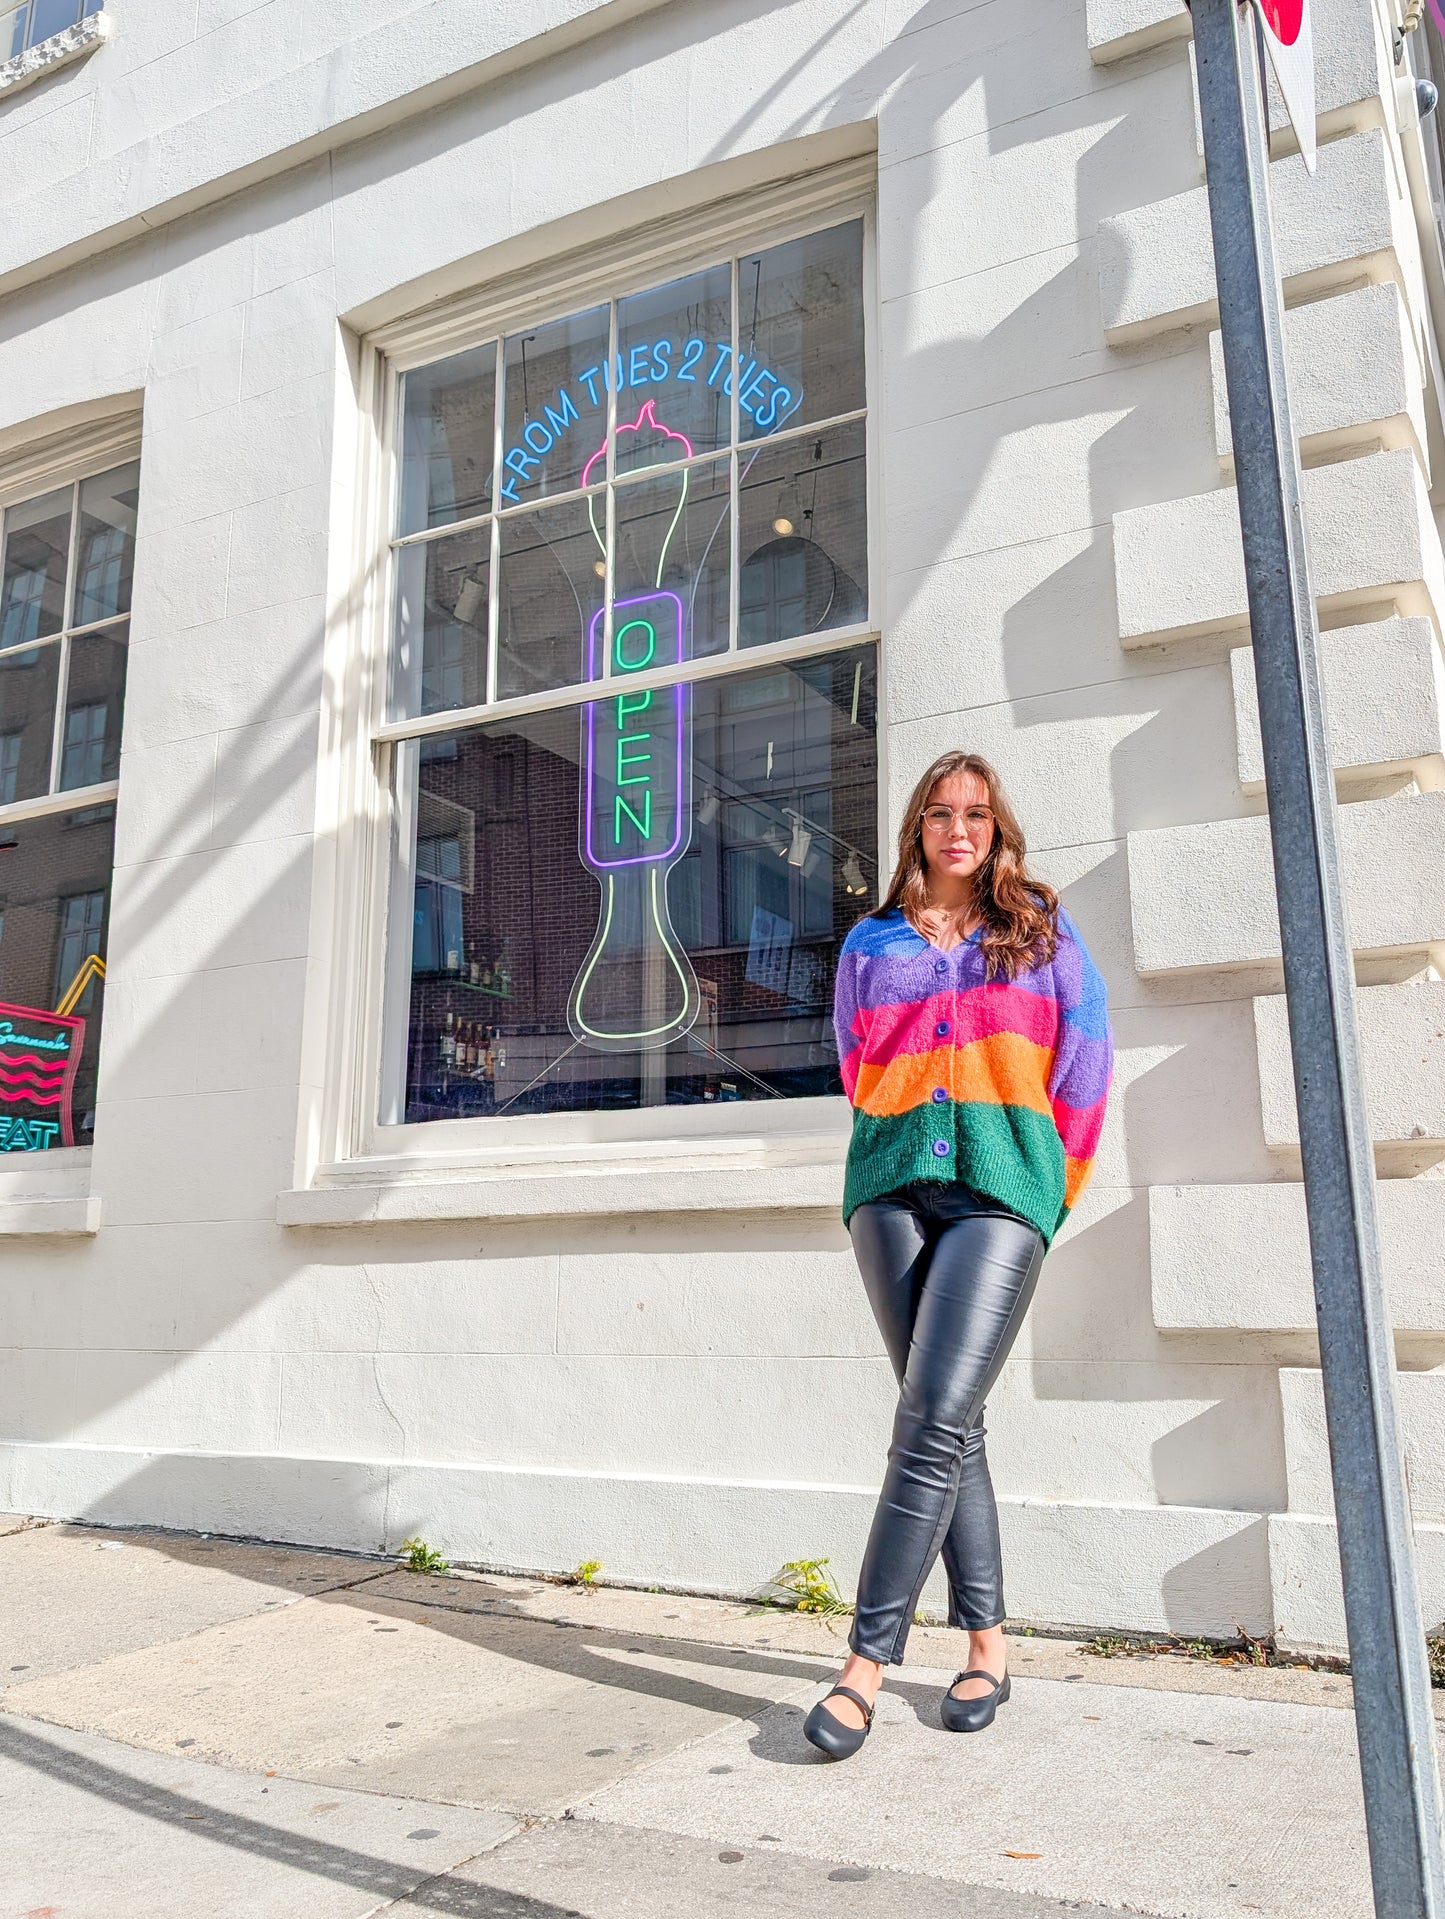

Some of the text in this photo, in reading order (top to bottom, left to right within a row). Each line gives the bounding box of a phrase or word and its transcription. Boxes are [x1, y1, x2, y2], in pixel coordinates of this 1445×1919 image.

[500, 338, 791, 501] FROM TUES 2 TUES
[615, 619, 655, 844] OPEN
